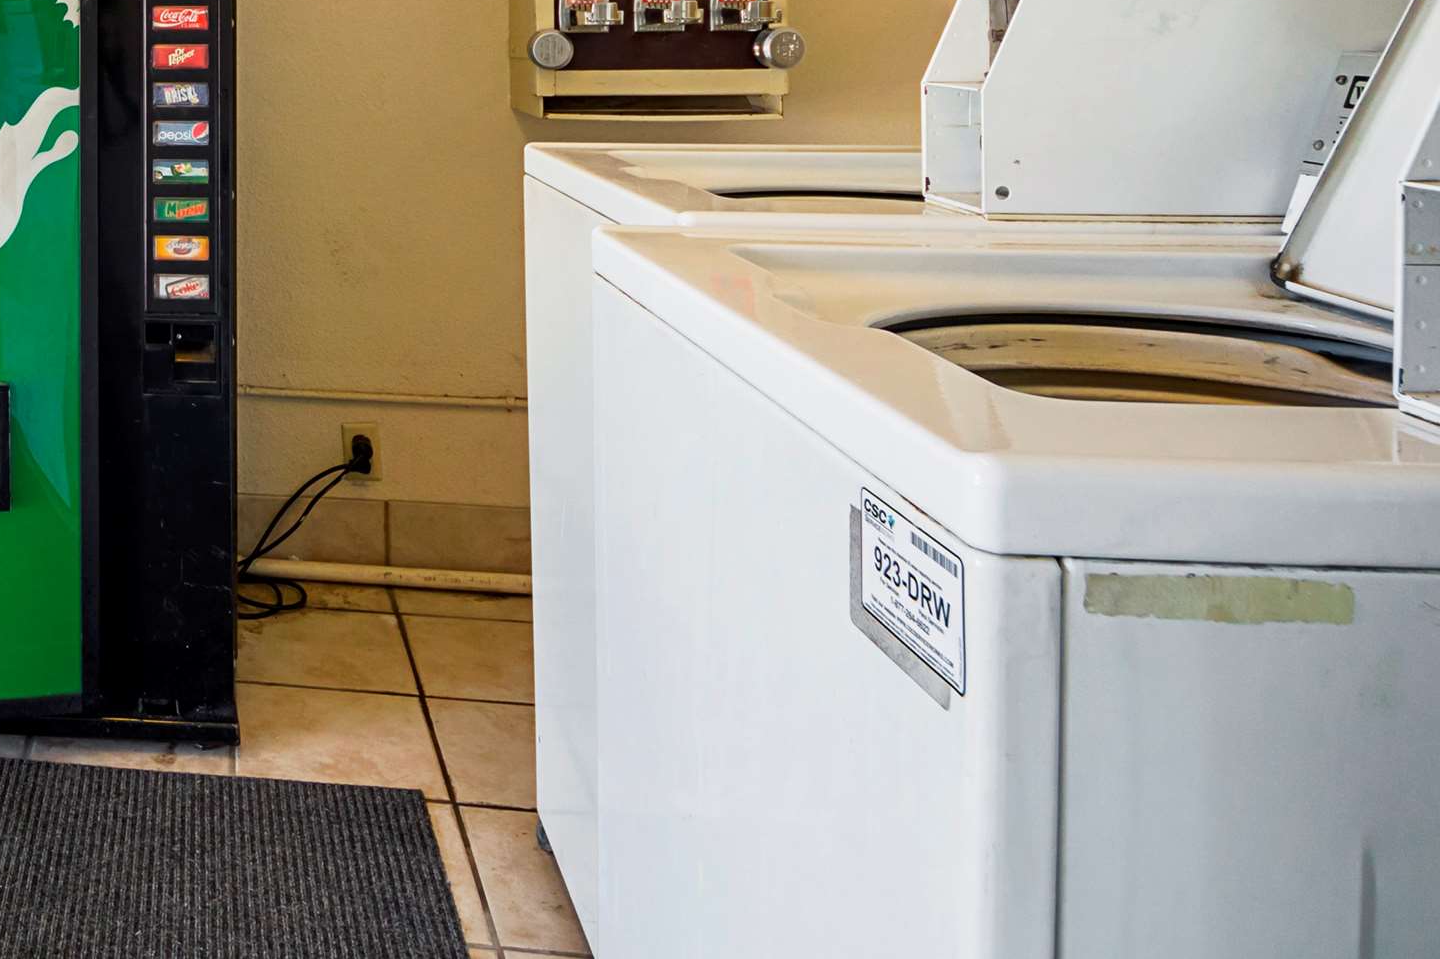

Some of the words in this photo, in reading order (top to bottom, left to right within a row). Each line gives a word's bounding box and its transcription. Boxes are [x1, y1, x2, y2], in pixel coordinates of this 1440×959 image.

[168, 50, 195, 66] Pepper
[158, 130, 190, 142] pepsi
[864, 498, 886, 523] CSC
[874, 545, 951, 628] 923-DRW
